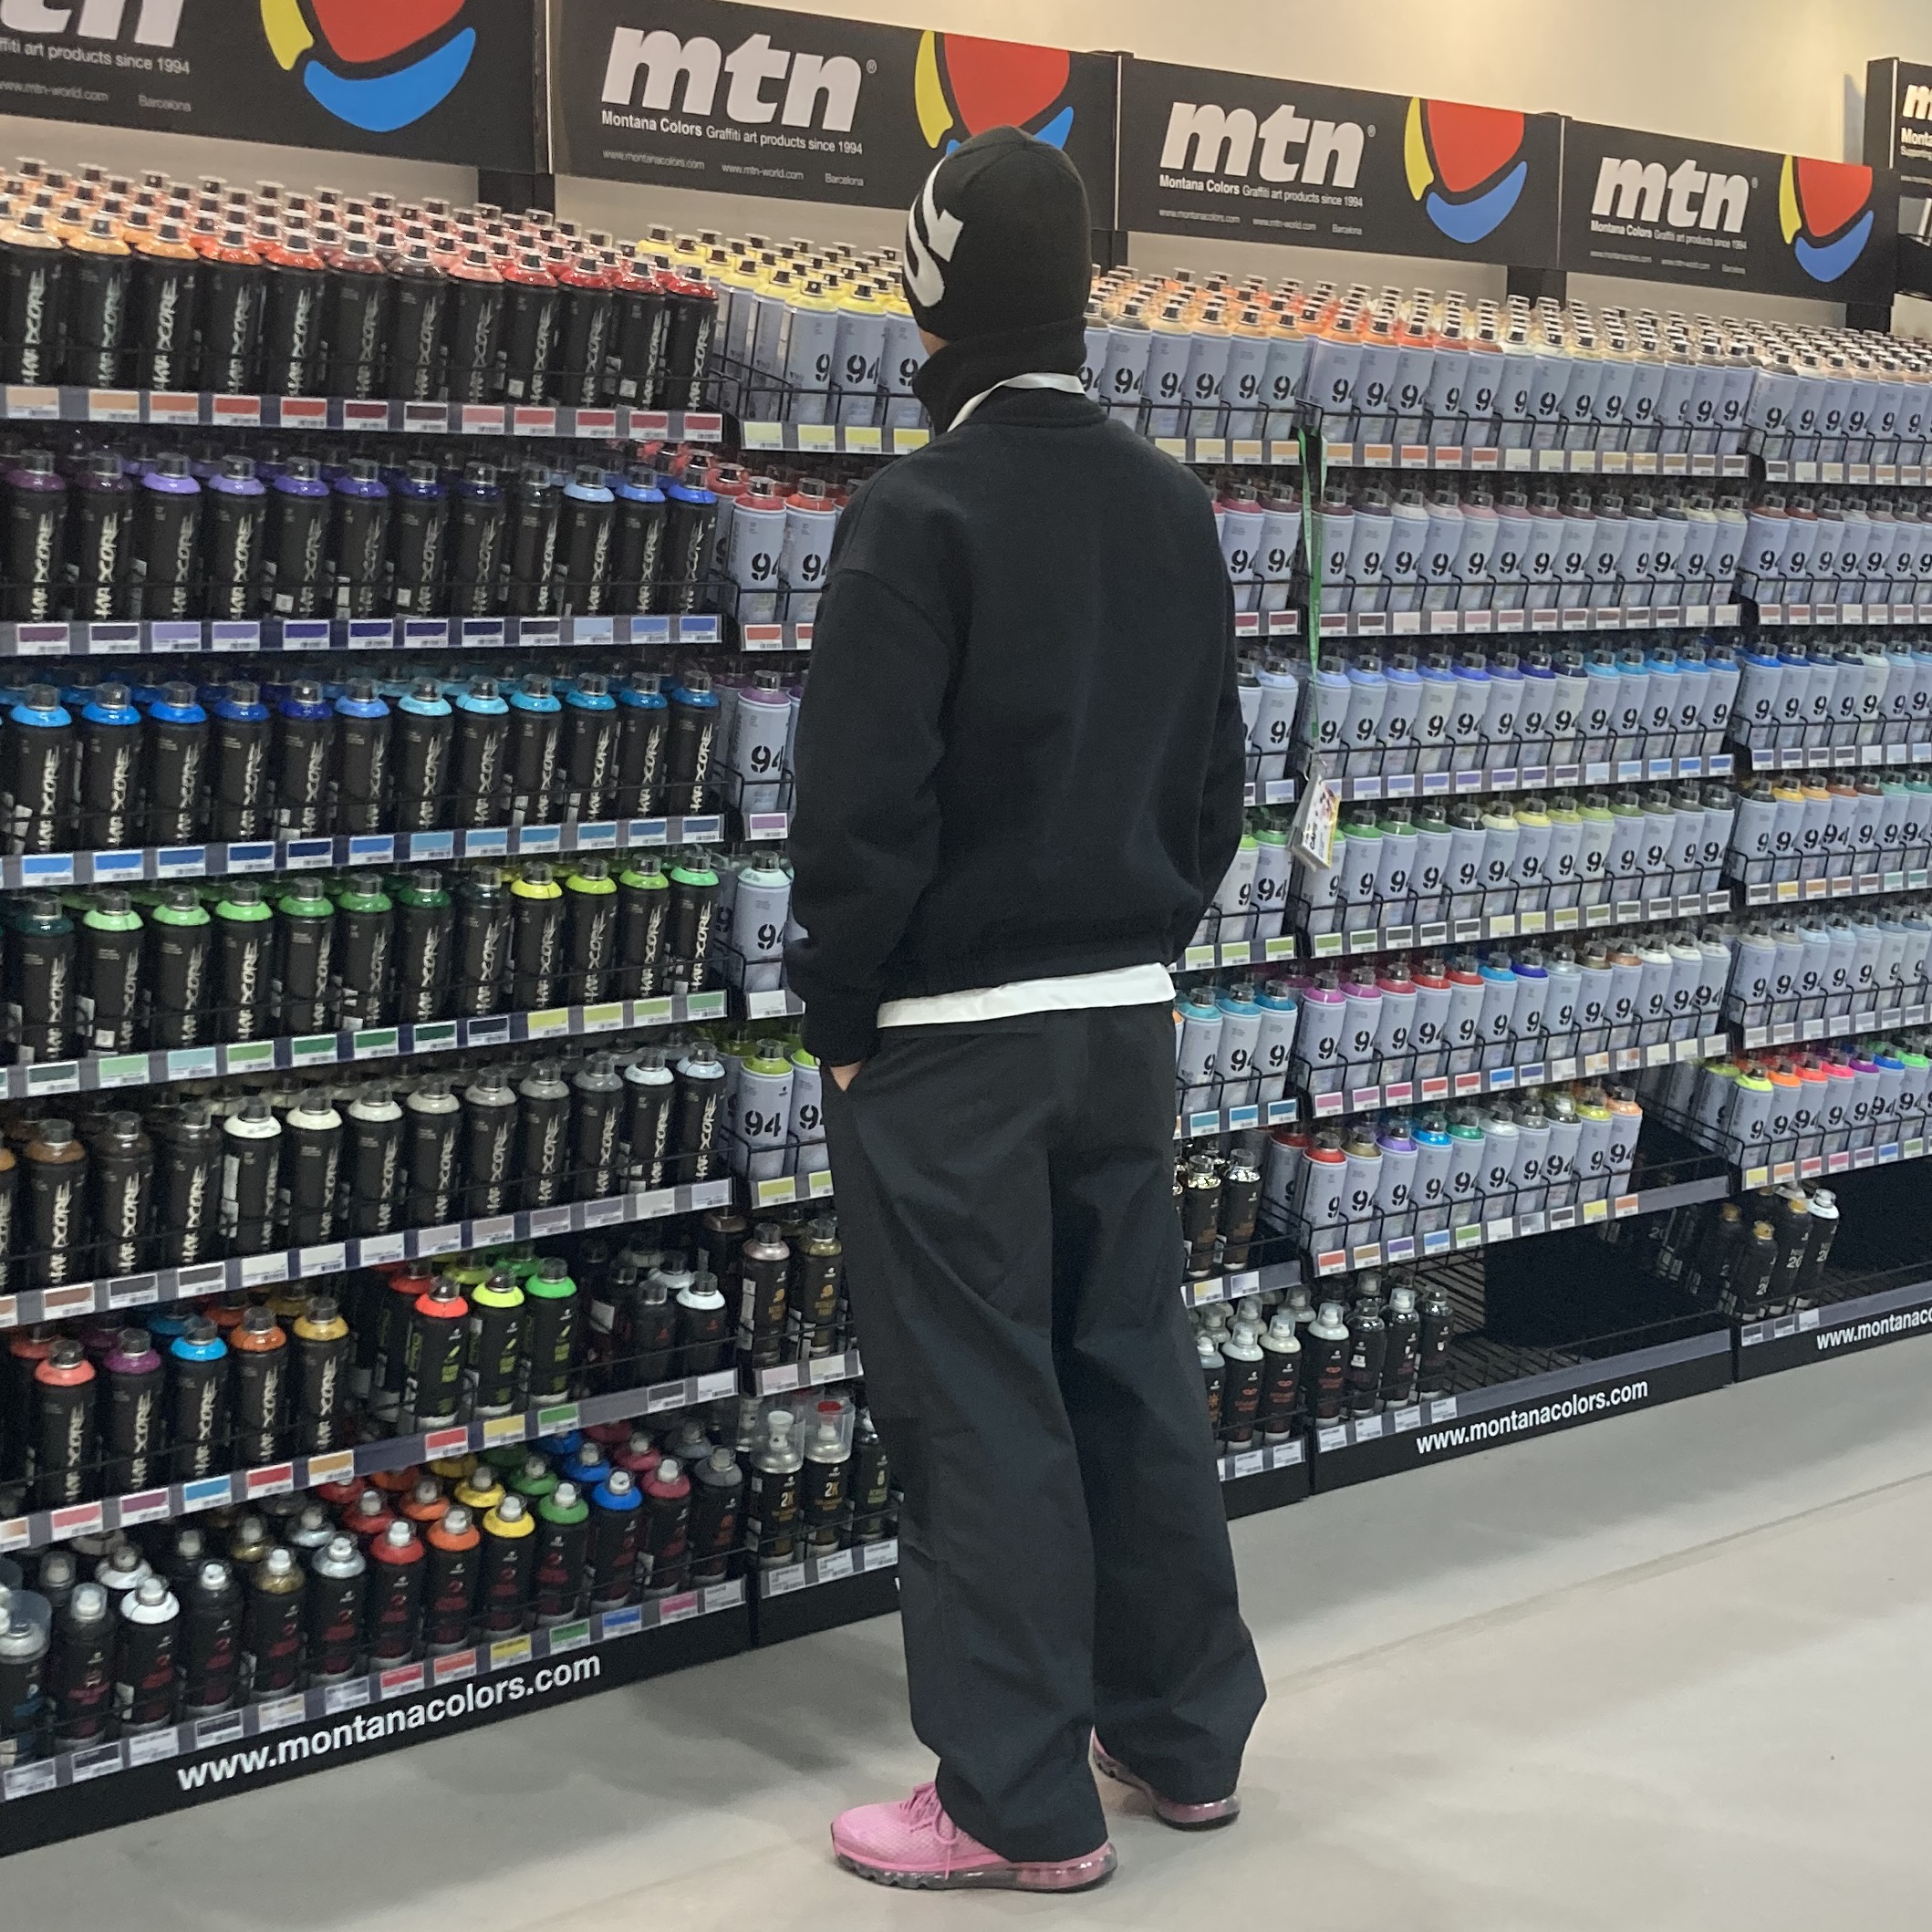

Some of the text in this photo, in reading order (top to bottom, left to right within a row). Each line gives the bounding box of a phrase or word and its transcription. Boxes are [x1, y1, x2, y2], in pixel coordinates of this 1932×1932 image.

[25, 42, 44, 57] art
[47, 47, 112, 66] products
[115, 54, 153, 70] since
[157, 57, 191, 76] 1994
[601, 26, 862, 132] mtn
[601, 109, 863, 155] Montana Colors Graffiti art products since 1994
[1159, 101, 1365, 189] mtn
[1159, 173, 1204, 192] Montana
[1206, 180, 1241, 195] Colors
[1271, 190, 1283, 201] art
[1283, 192, 1321, 205] products
[1321, 194, 1343, 207] since
[1344, 196, 1364, 208] 1994
[1591, 156, 1750, 234] mtn
[1626, 224, 1653, 239] Colors
[847, 354, 879, 384] 94
[1114, 368, 1146, 394] 94
[751, 745, 784, 773] 94
[1823, 824, 1849, 845] 94
[1258, 878, 1287, 901] 94
[1695, 985, 1723, 1005] 94
[1795, 1110, 1820, 1128] 94
[1871, 1096, 1896, 1117] 94
[744, 1110, 781, 1137] 94
[1547, 1155, 1574, 1176] 94
[1416, 1380, 1648, 1454] www.montanacolors.com
[177, 1654, 601, 1791] www.montanacolors.com
